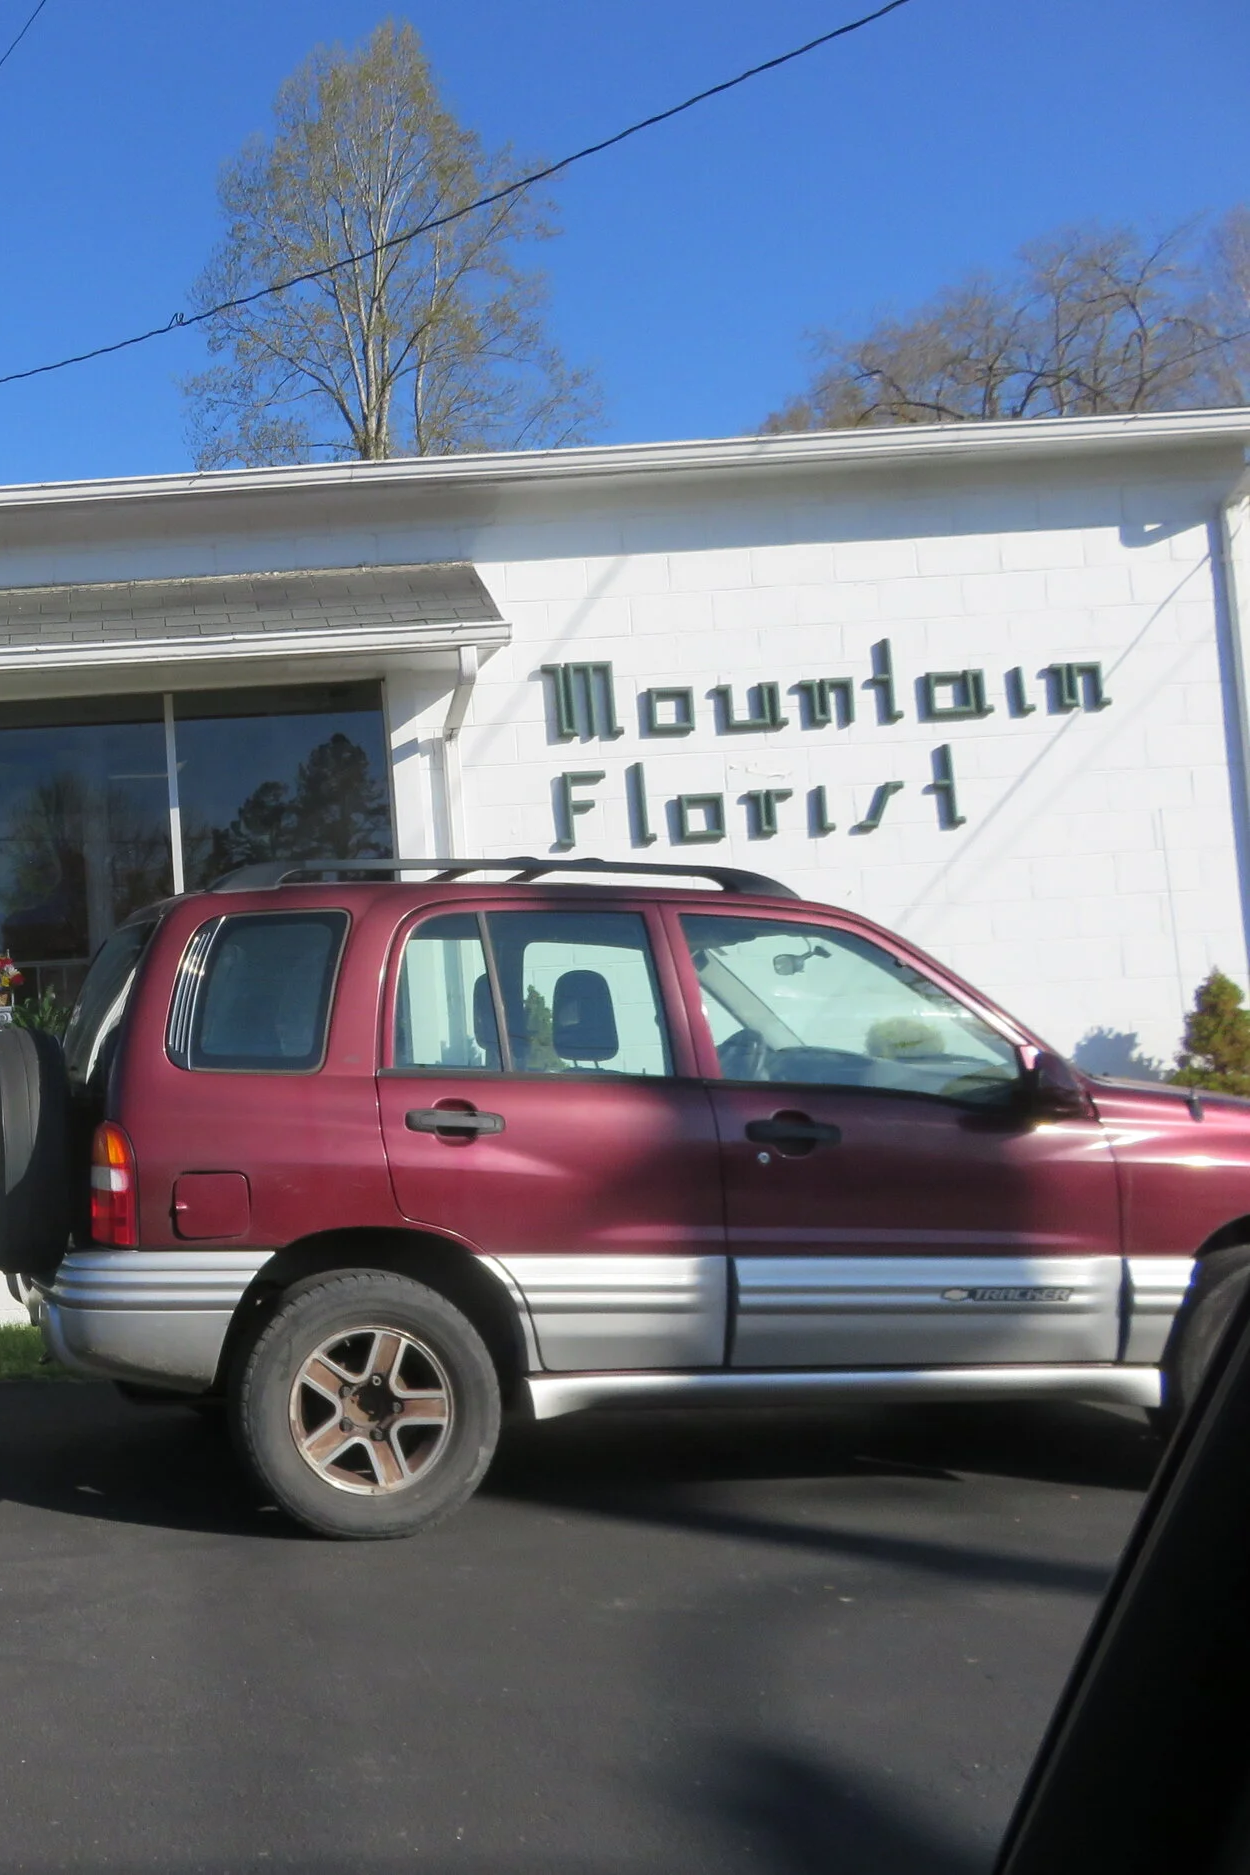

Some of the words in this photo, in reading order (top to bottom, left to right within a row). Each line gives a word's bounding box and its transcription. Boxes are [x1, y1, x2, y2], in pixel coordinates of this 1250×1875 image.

[540, 637, 1113, 740] Mountain
[553, 743, 967, 849] Florist
[973, 1288, 1073, 1301] TRACKER
